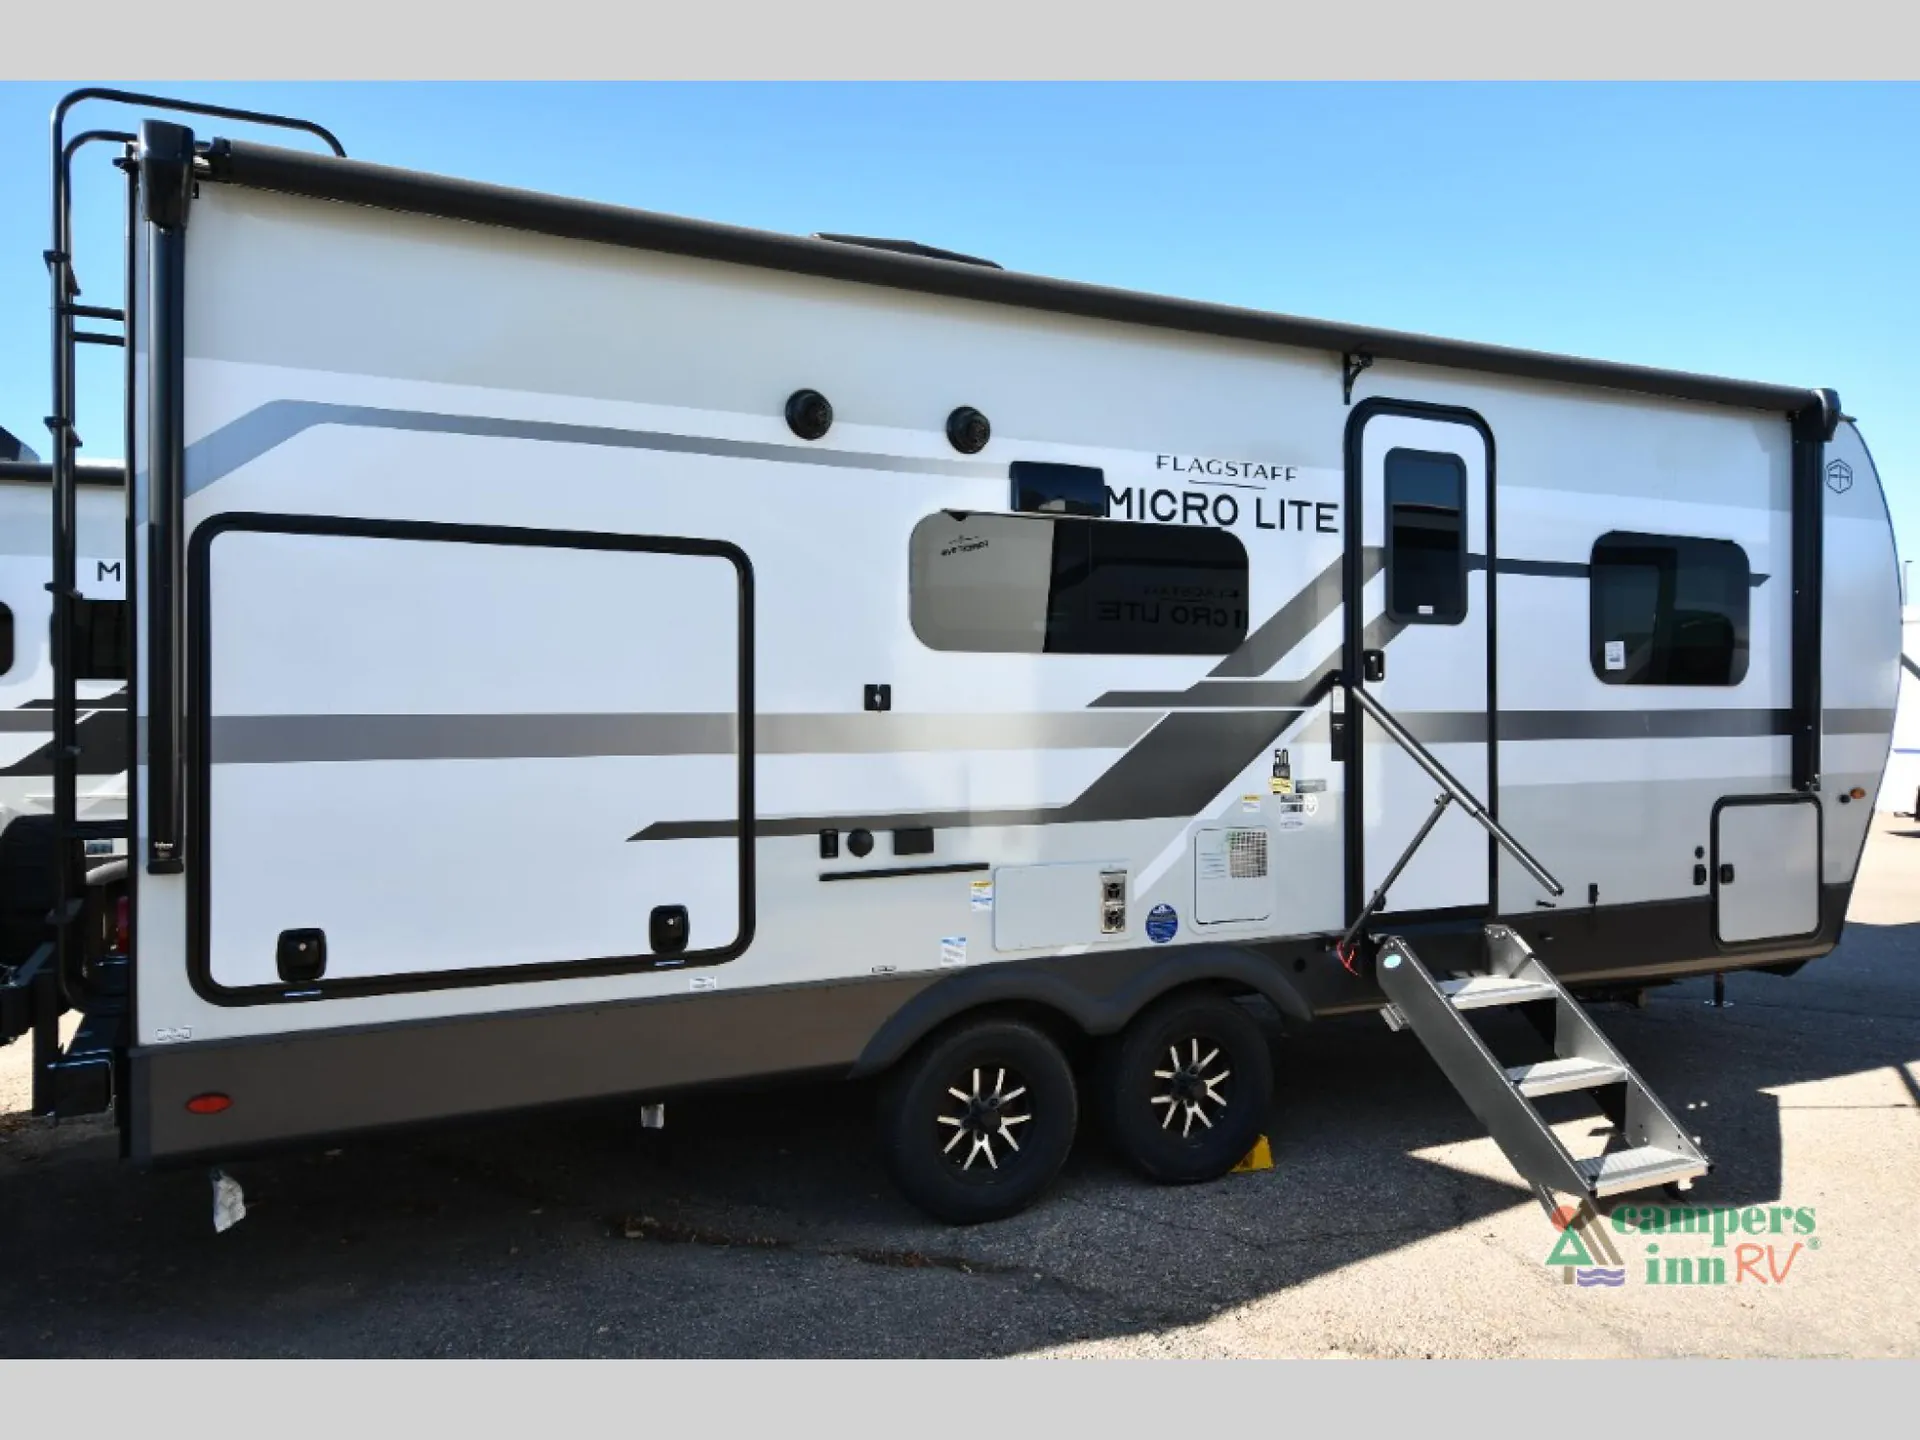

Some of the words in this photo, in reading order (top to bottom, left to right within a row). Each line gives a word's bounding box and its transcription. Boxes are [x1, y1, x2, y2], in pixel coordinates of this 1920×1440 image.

[1156, 454, 1298, 481] FLAGSTAFF
[1104, 485, 1238, 526] MICRO
[1255, 497, 1338, 533] LITE
[1274, 748, 1289, 765] 50
